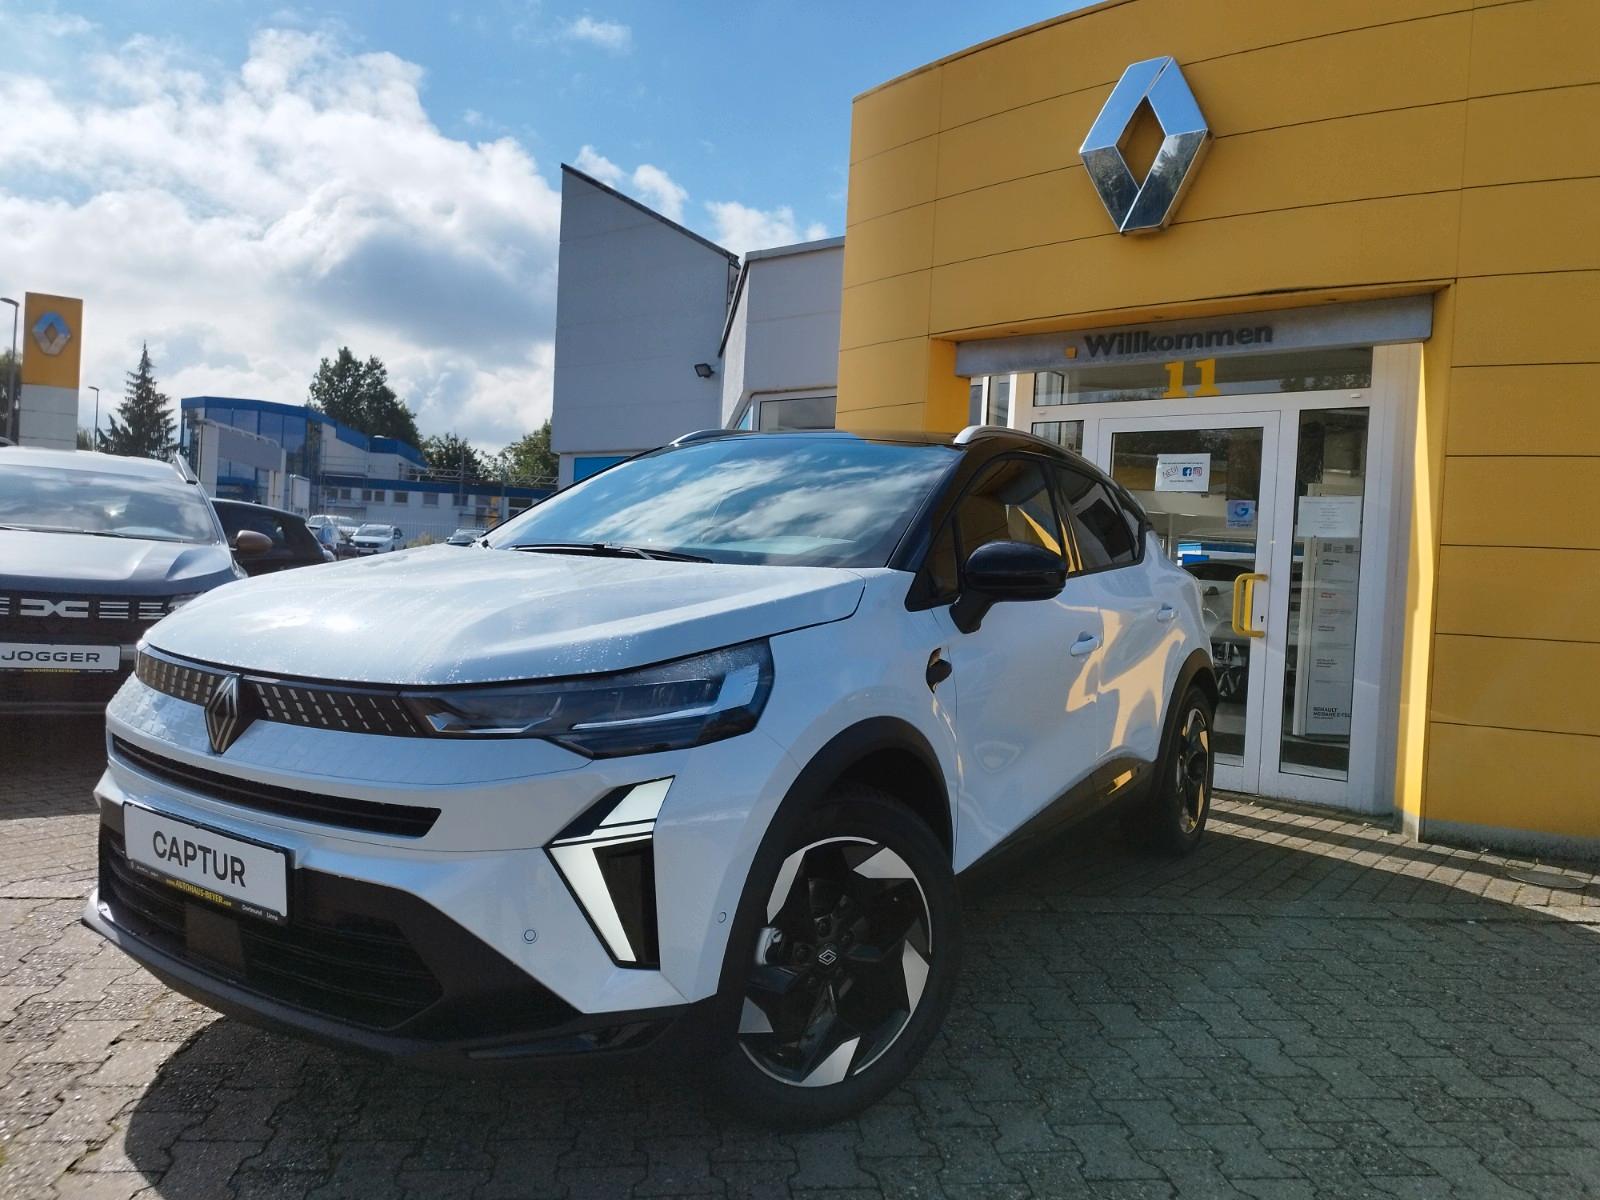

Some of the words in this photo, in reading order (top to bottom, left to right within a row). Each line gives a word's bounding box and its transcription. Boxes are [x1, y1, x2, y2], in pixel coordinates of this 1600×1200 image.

[1083, 326, 1273, 358] Willkommen
[1161, 358, 1221, 399] 11
[1, 650, 101, 663] JOGGER
[153, 830, 247, 888] CAPTUR
